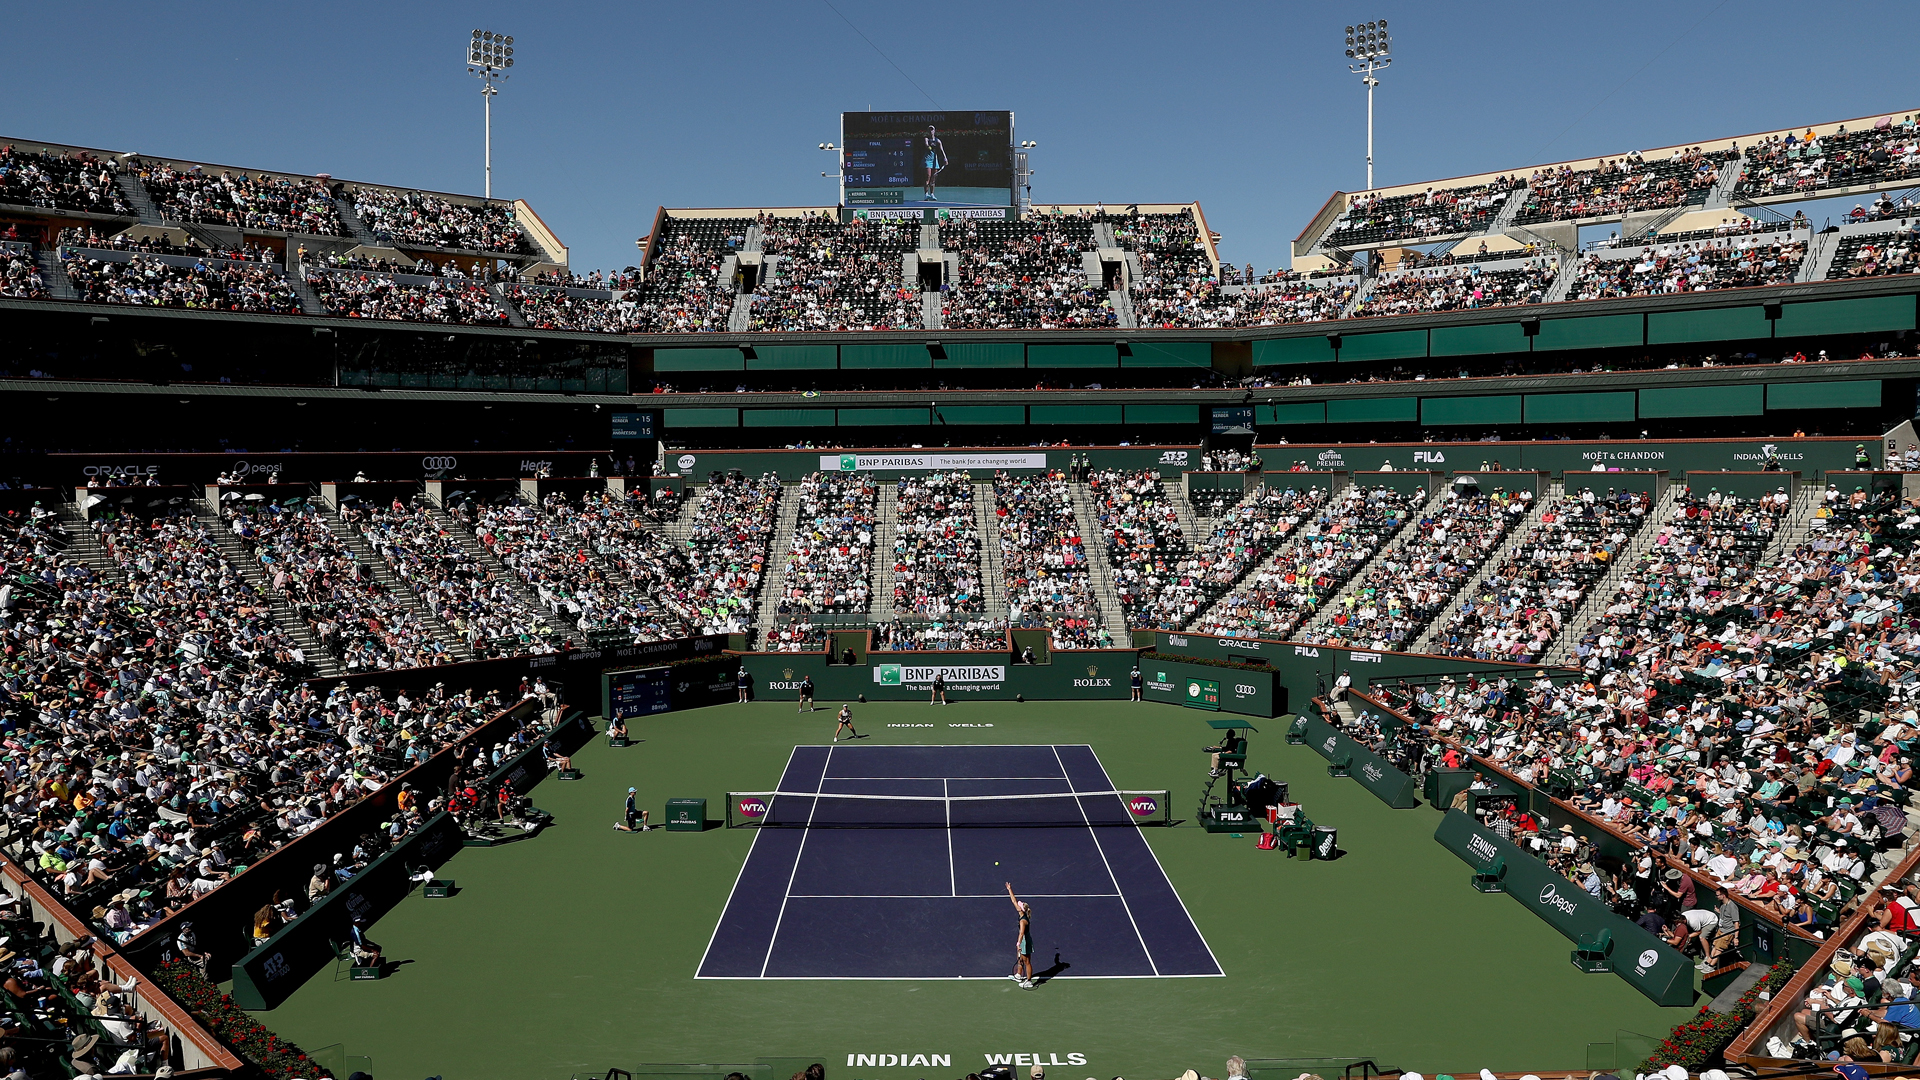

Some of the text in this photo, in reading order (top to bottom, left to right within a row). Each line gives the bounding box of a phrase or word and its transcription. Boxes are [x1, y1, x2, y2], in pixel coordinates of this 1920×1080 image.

[902, 114, 945, 122] CHANDON
[870, 210, 921, 218] BNP PARIBAS
[951, 210, 1002, 218] BNP PARIBAS
[1242, 422, 1252, 430] 15
[1162, 451, 1188, 461] ATP
[1318, 452, 1342, 461] Corona
[1414, 451, 1445, 464] FILA
[1582, 450, 1608, 460] MOËT
[1617, 452, 1664, 460] CHANDON
[520, 460, 552, 471] Hertz
[859, 458, 924, 466] BNP PARIBAS
[966, 458, 976, 466] for
[982, 458, 1008, 466] changing
[83, 465, 158, 476] ORACLE
[251, 462, 283, 475] pepsi
[643, 642, 678, 653] CHANDON
[1218, 638, 1260, 650] ORACLE
[1294, 646, 1320, 658] FILA
[1350, 652, 1382, 663] ESPN
[906, 668, 999, 680] BNP PARIBAS
[1074, 678, 1112, 686] ROLEX
[952, 684, 980, 692] changing
[740, 803, 766, 812] WTA
[1130, 802, 1156, 811] WTA
[1220, 812, 1244, 821] FILA
[1318, 834, 1334, 857] Penn
[1469, 833, 1498, 858] TENNIS
[1466, 844, 1492, 862] WAREHOUSE
[1550, 892, 1578, 916] pepsi
[1758, 936, 1768, 952] 16
[161, 950, 170, 962] 16
[1642, 952, 1654, 965] WTA
[264, 952, 284, 978] ATP
[846, 1052, 1088, 1066] INDIAN WELLS
